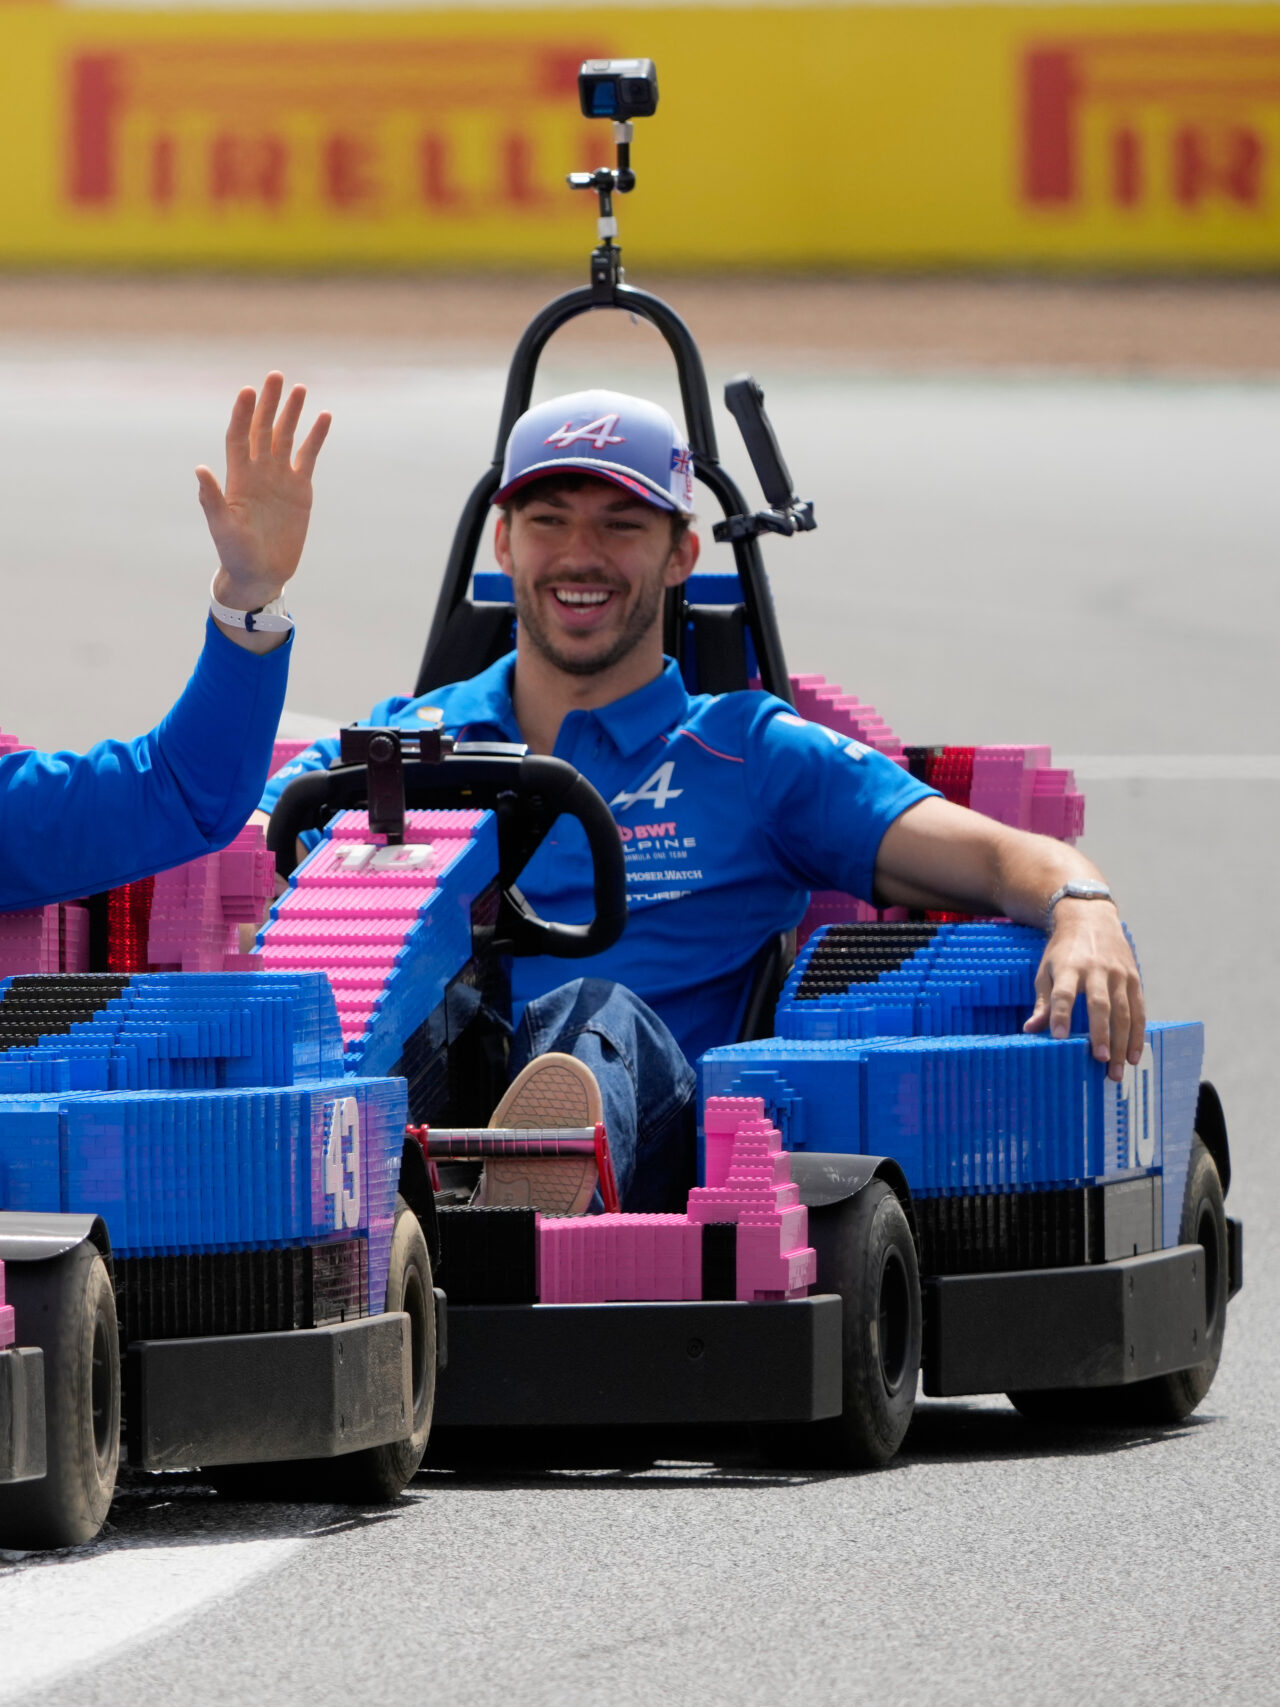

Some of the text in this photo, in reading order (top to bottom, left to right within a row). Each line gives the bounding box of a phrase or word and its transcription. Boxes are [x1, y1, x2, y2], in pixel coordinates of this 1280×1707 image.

[634, 821, 677, 839] BWT
[622, 837, 697, 853] LPINE
[334, 843, 435, 872] 10
[323, 1097, 361, 1231] 43
